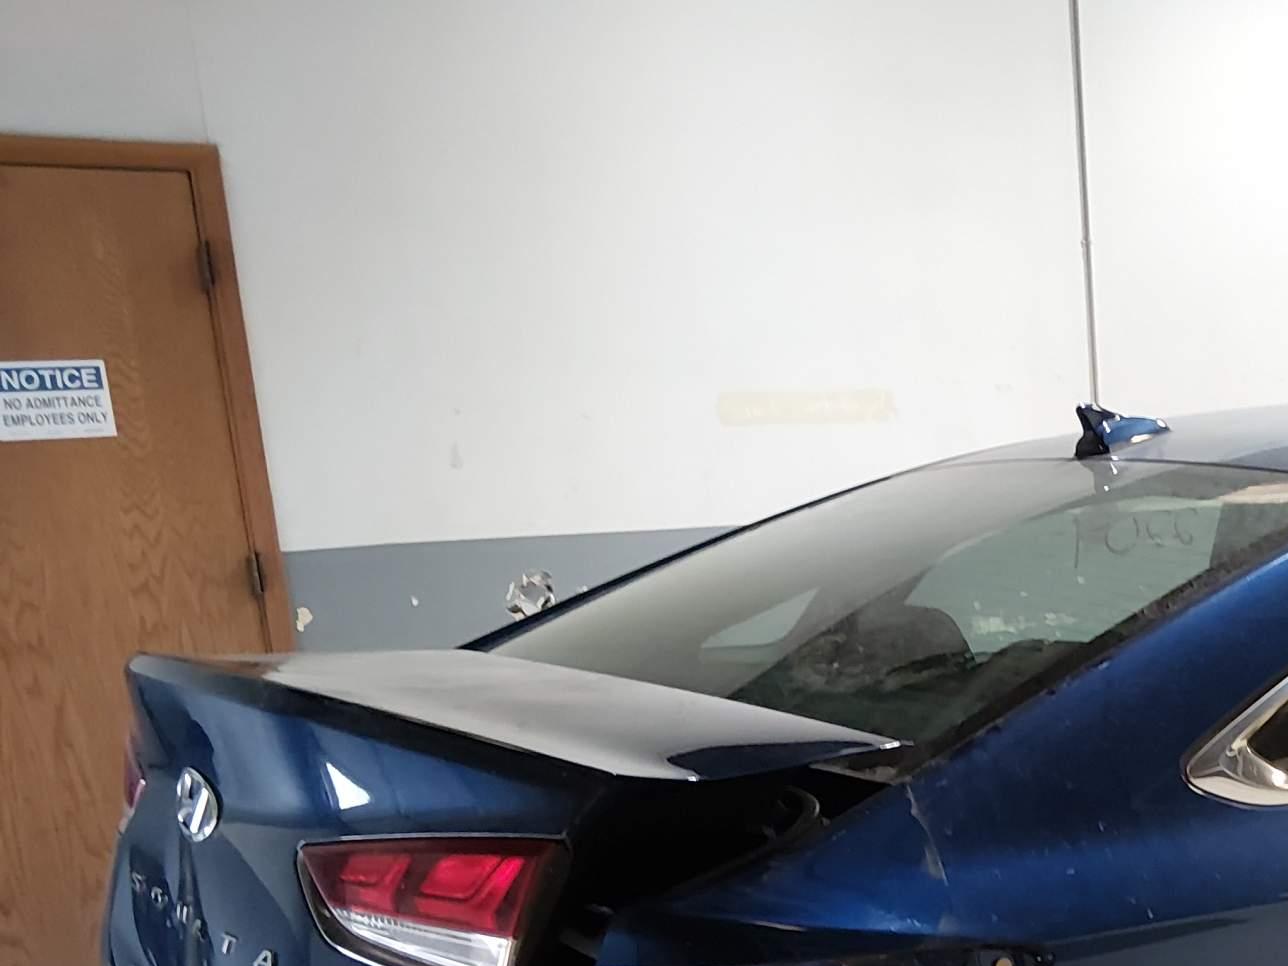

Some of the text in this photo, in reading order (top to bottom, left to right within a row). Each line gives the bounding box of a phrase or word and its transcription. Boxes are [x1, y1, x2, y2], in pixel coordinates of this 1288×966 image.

[0, 368, 99, 390] NOTICE
[3, 395, 103, 411] NO ADMITTANCE
[3, 411, 108, 427] EMPLOYEES ONLY
